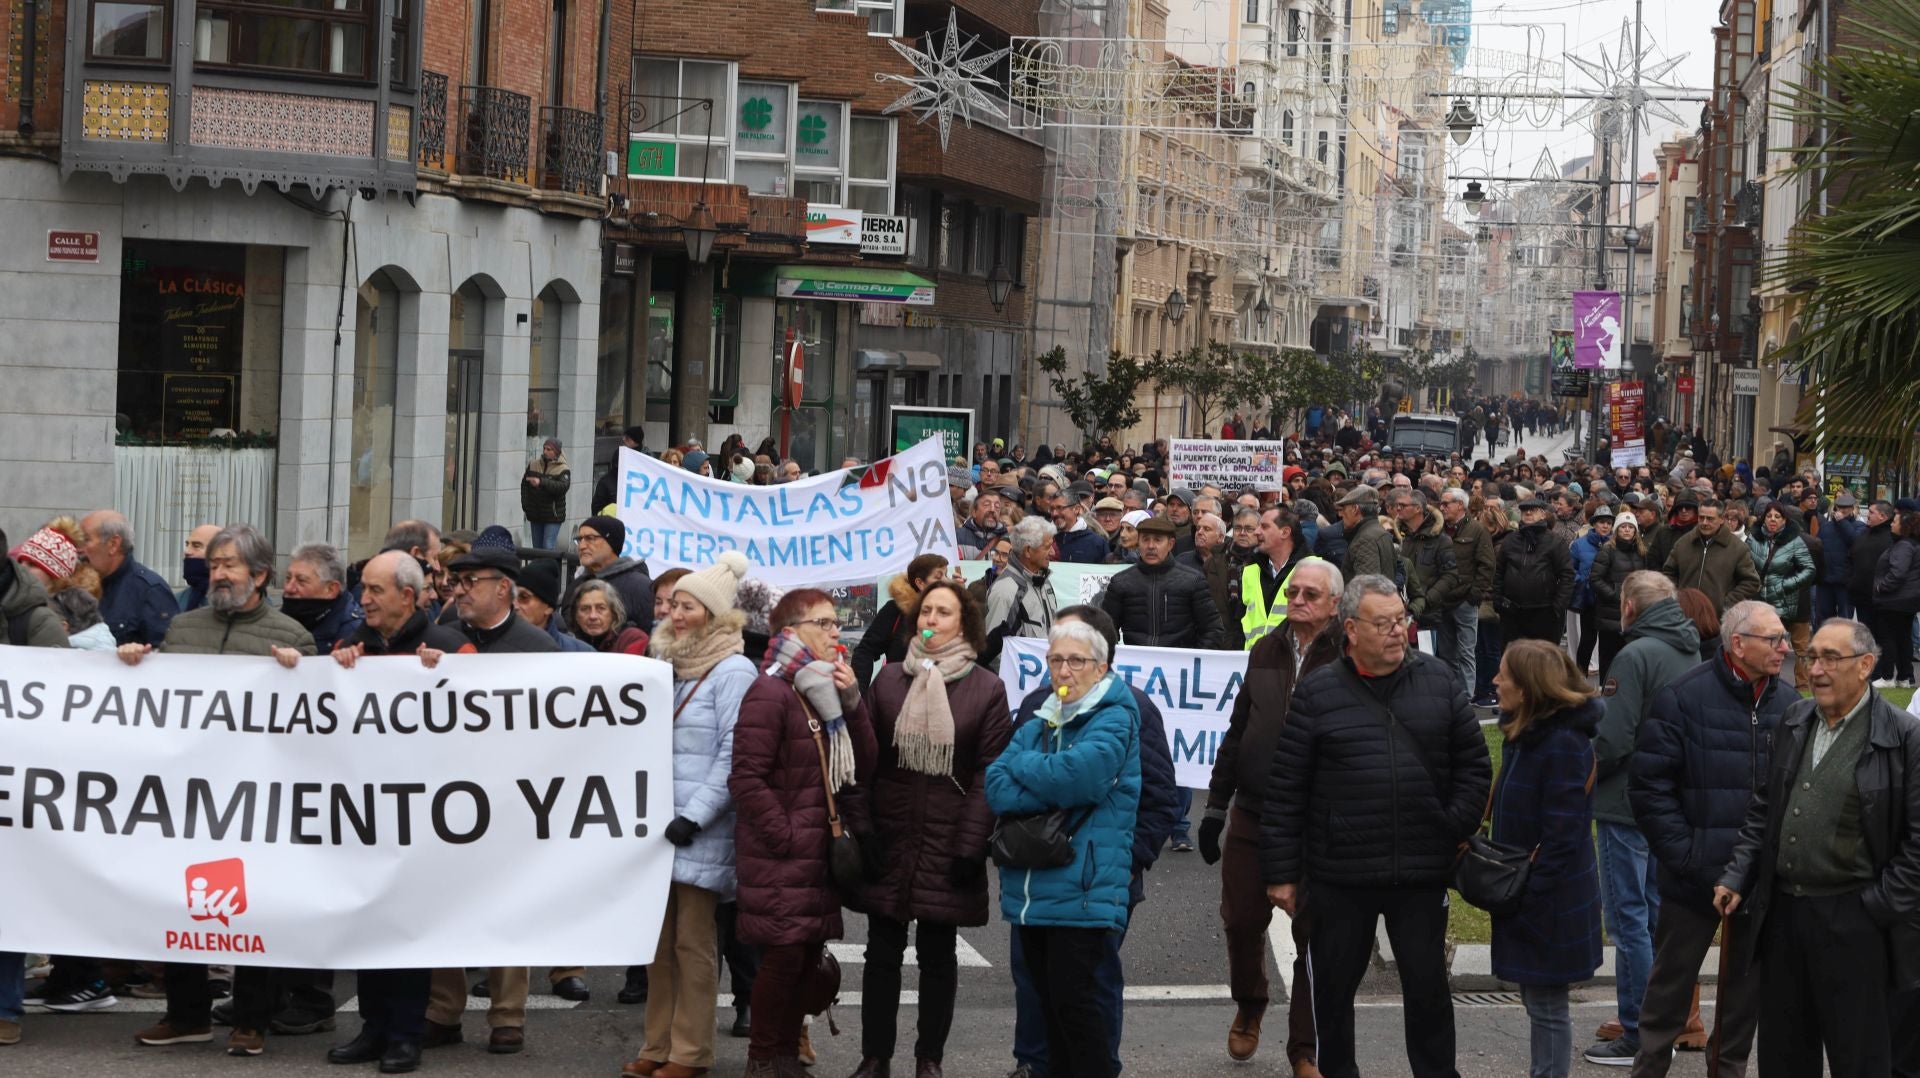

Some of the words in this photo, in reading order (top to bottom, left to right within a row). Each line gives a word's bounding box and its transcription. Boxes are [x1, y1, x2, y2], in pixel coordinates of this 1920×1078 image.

[639, 146, 664, 171] GTH
[862, 217, 904, 233] TIERRA
[55, 237, 80, 245] CALLE
[159, 279, 177, 294] LA
[183, 275, 245, 297] CLÁSICA
[183, 335, 218, 343] DESAYUNOS
[922, 428, 931, 437] El
[1173, 453, 1181, 462] NI
[1183, 454, 1217, 462] PUENTES
[1173, 464, 1197, 472] JUNTA
[1199, 464, 1209, 472] DE
[624, 471, 863, 527] PANTALLAS
[888, 460, 947, 508] NO
[908, 517, 952, 557] YA
[62, 684, 338, 735] PANTALLAS
[352, 678, 648, 734] ACÚSTICAS
[516, 770, 648, 840] YA!
[166, 930, 265, 953] PALENCIA
